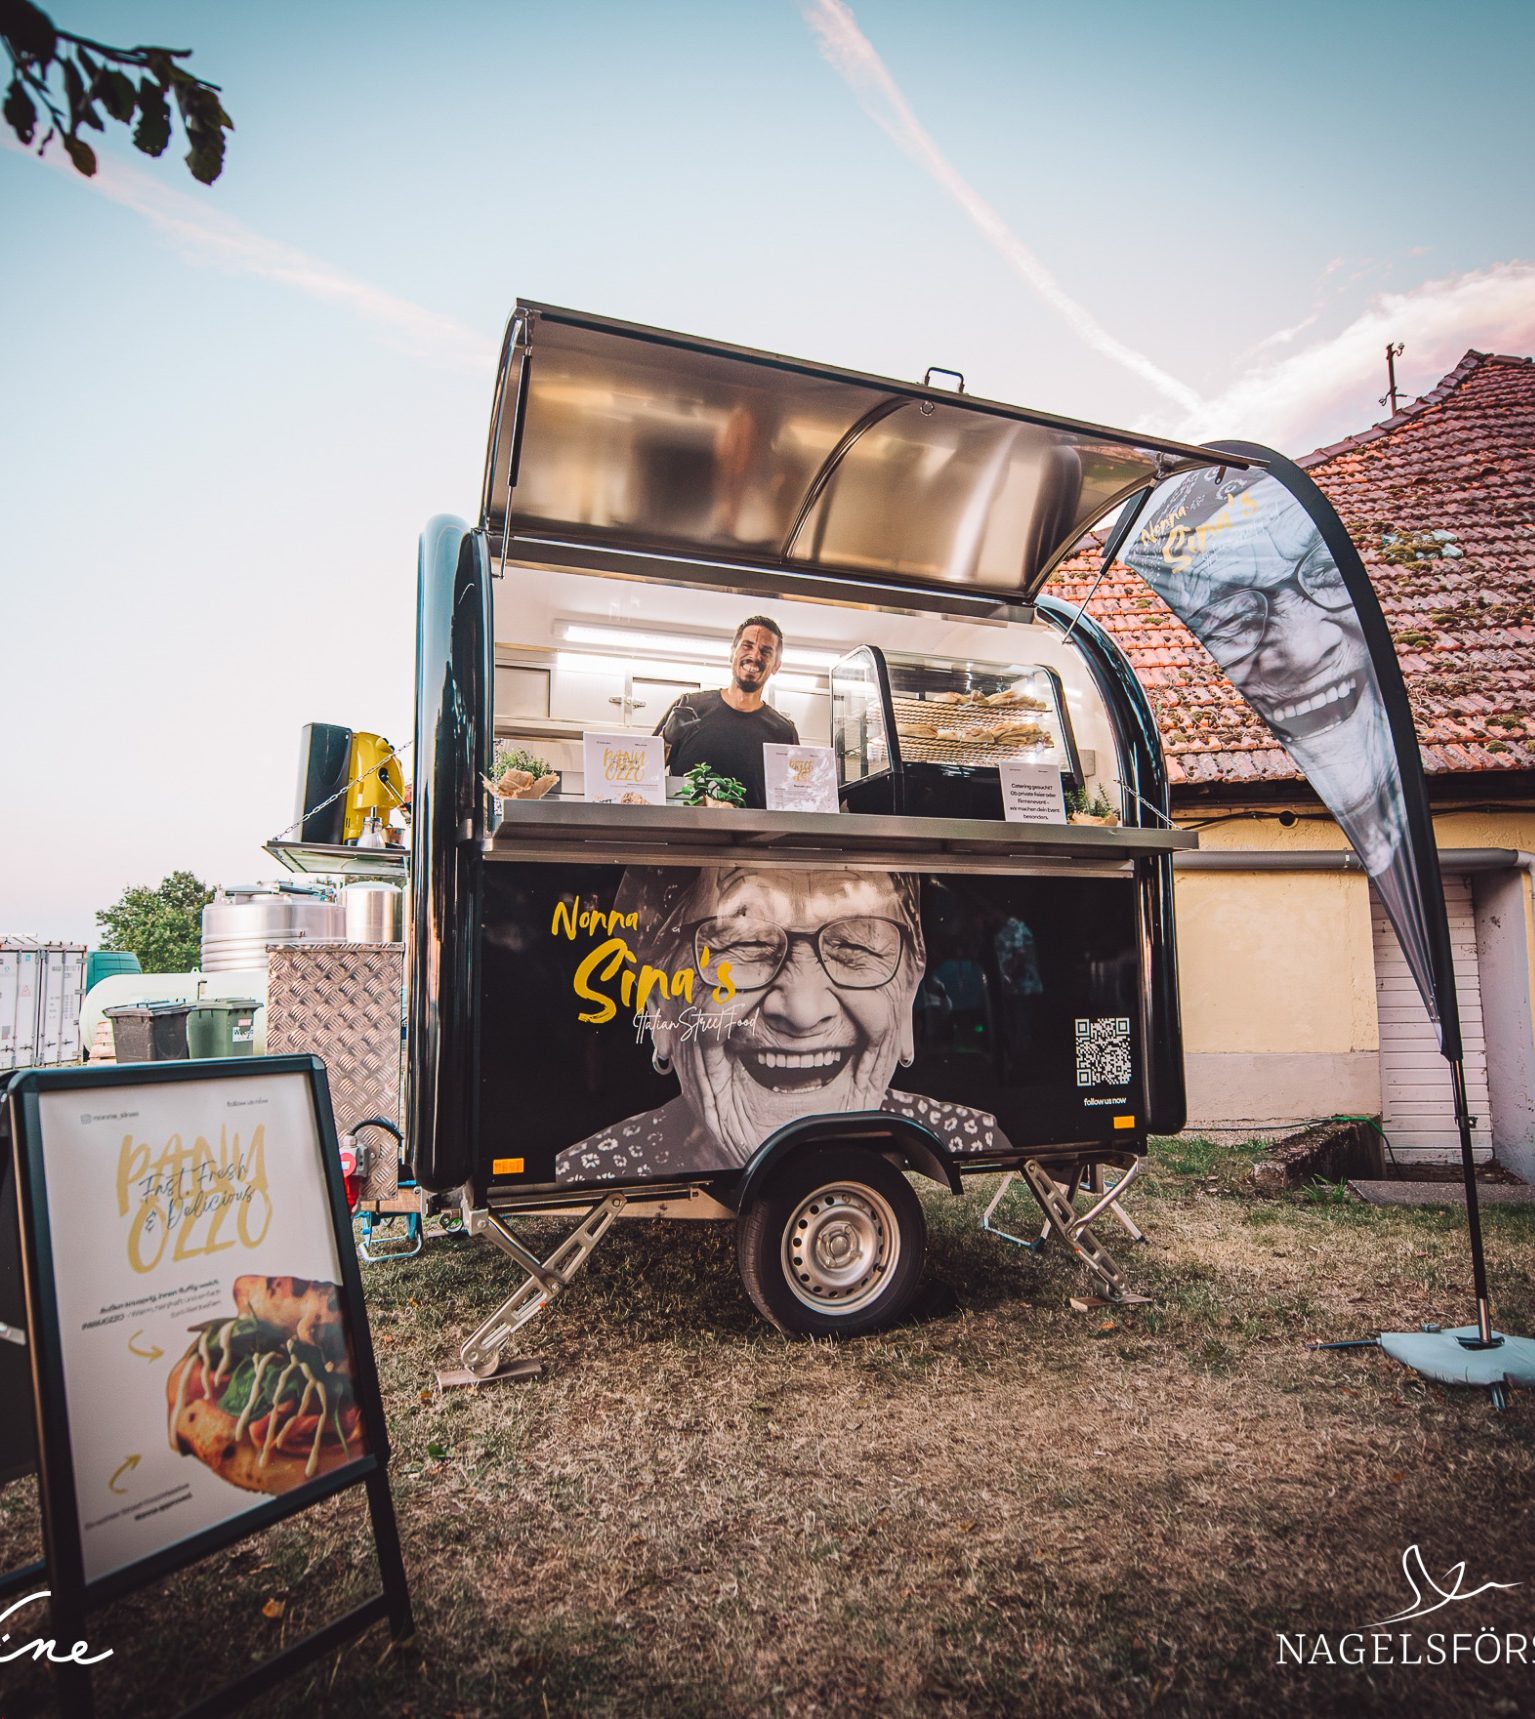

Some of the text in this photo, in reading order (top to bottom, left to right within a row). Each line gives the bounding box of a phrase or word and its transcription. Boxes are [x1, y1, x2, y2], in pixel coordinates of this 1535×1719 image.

[1140, 505, 1187, 546] Nonna
[1162, 493, 1258, 574] Sina's
[552, 895, 638, 940] Nonna
[573, 938, 736, 1024] Sina's
[633, 1003, 760, 1044] Italian Street Food
[1084, 1098, 1104, 1106] follow
